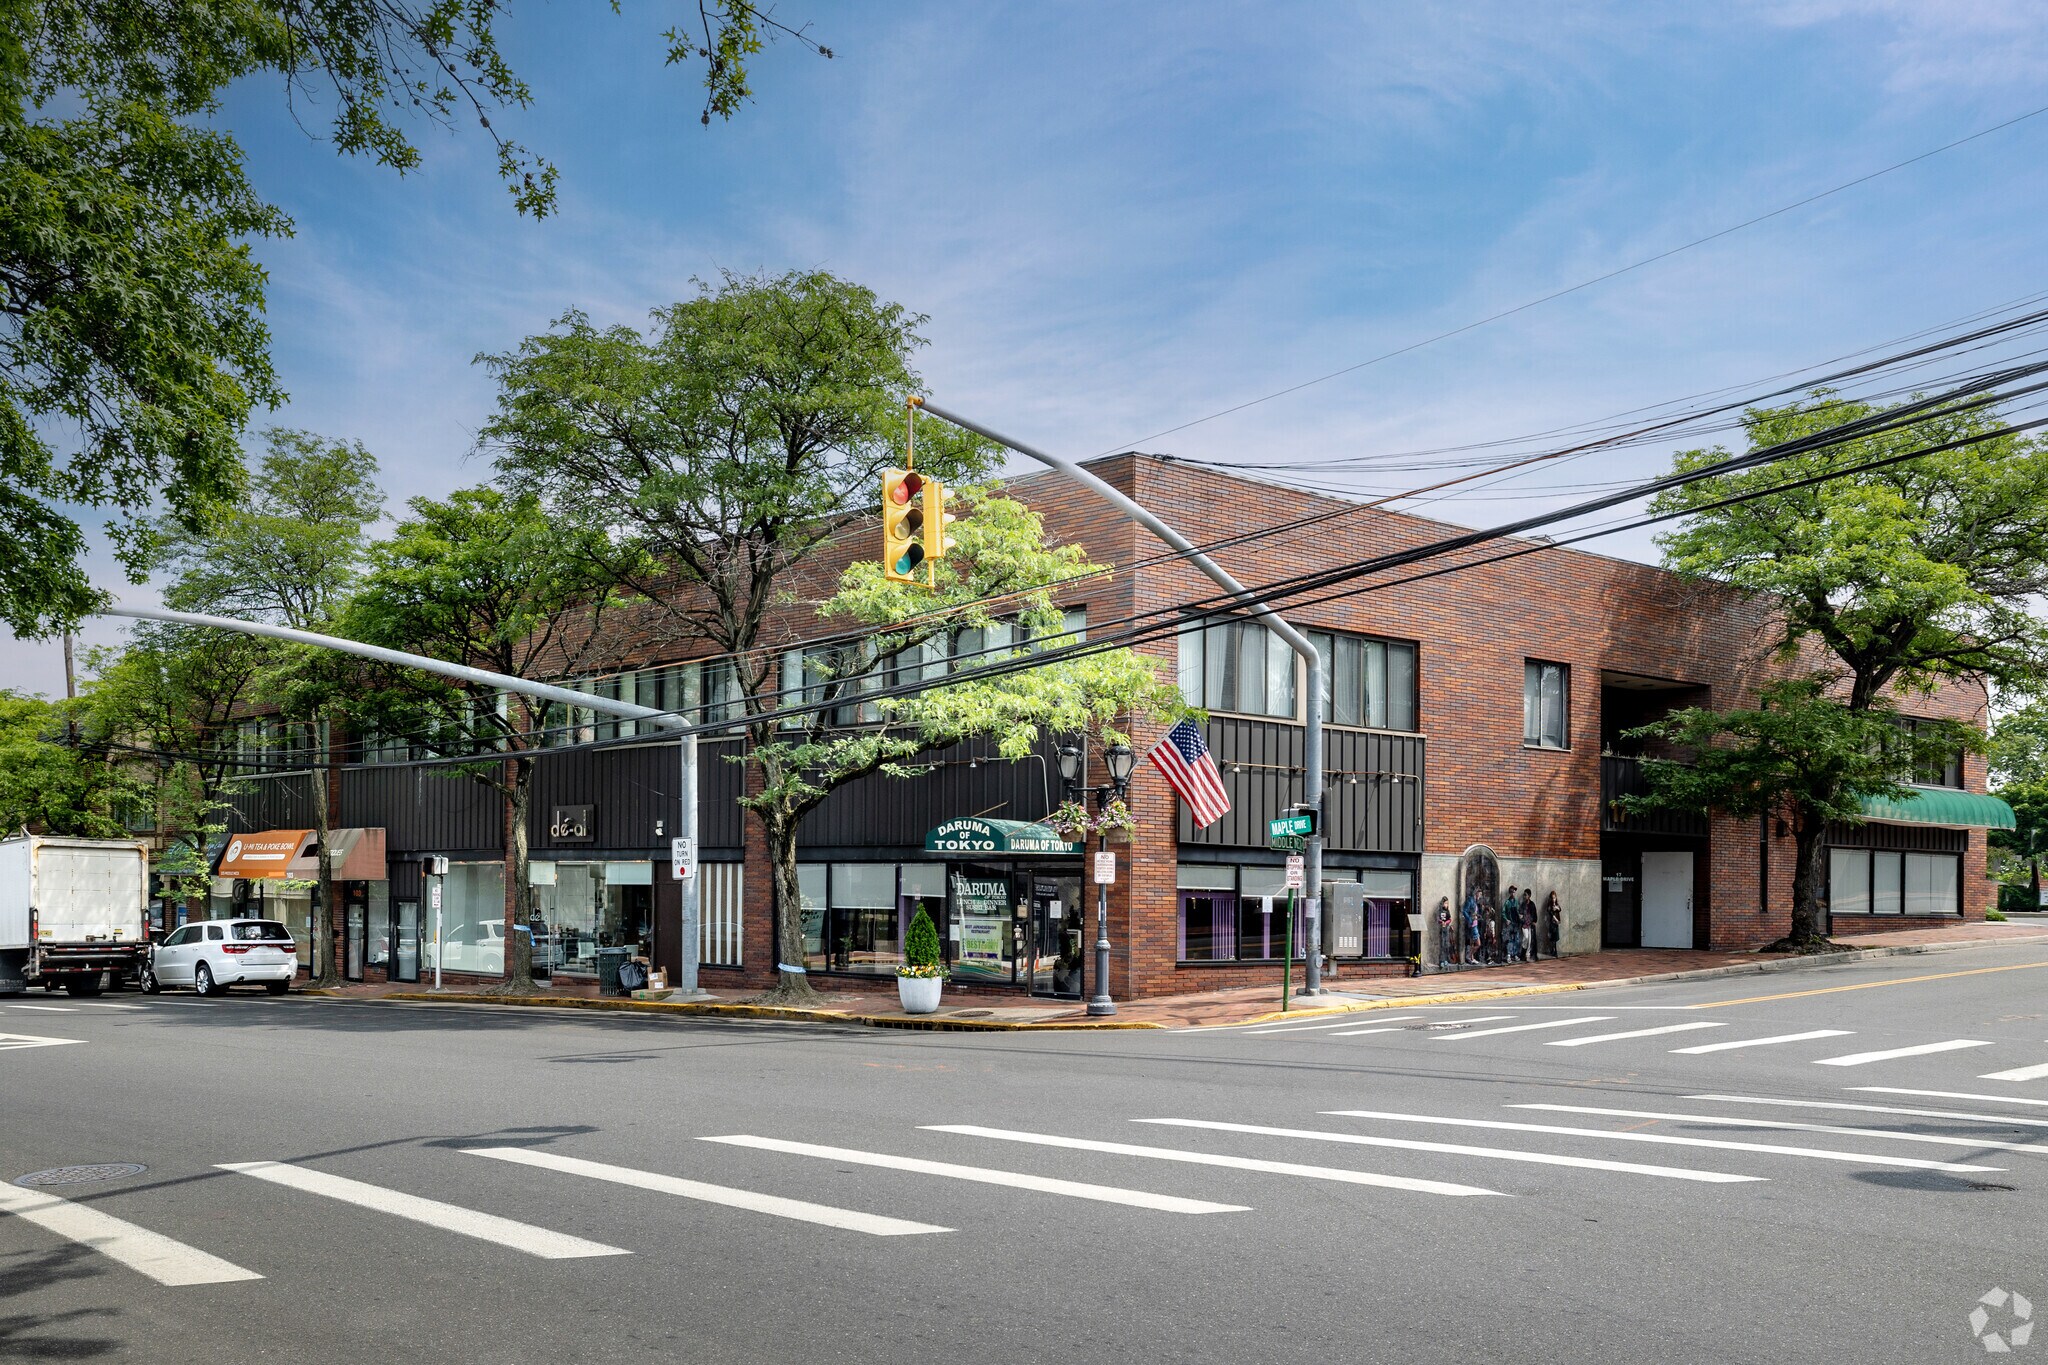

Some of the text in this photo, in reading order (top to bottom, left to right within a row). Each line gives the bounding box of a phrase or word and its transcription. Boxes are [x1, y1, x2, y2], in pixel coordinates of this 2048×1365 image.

[938, 820, 990, 837] DARUMA
[1271, 820, 1306, 835] MAPLE DRIVE
[959, 831, 970, 839] OF
[255, 843, 263, 851] TEA
[280, 842, 294, 850] BOWL
[934, 840, 995, 850] TOKYO
[1011, 839, 1073, 851] DARUMA OF TOKYO
[1271, 836, 1293, 849] MIDDLE
[956, 882, 1007, 896] DARUMA
